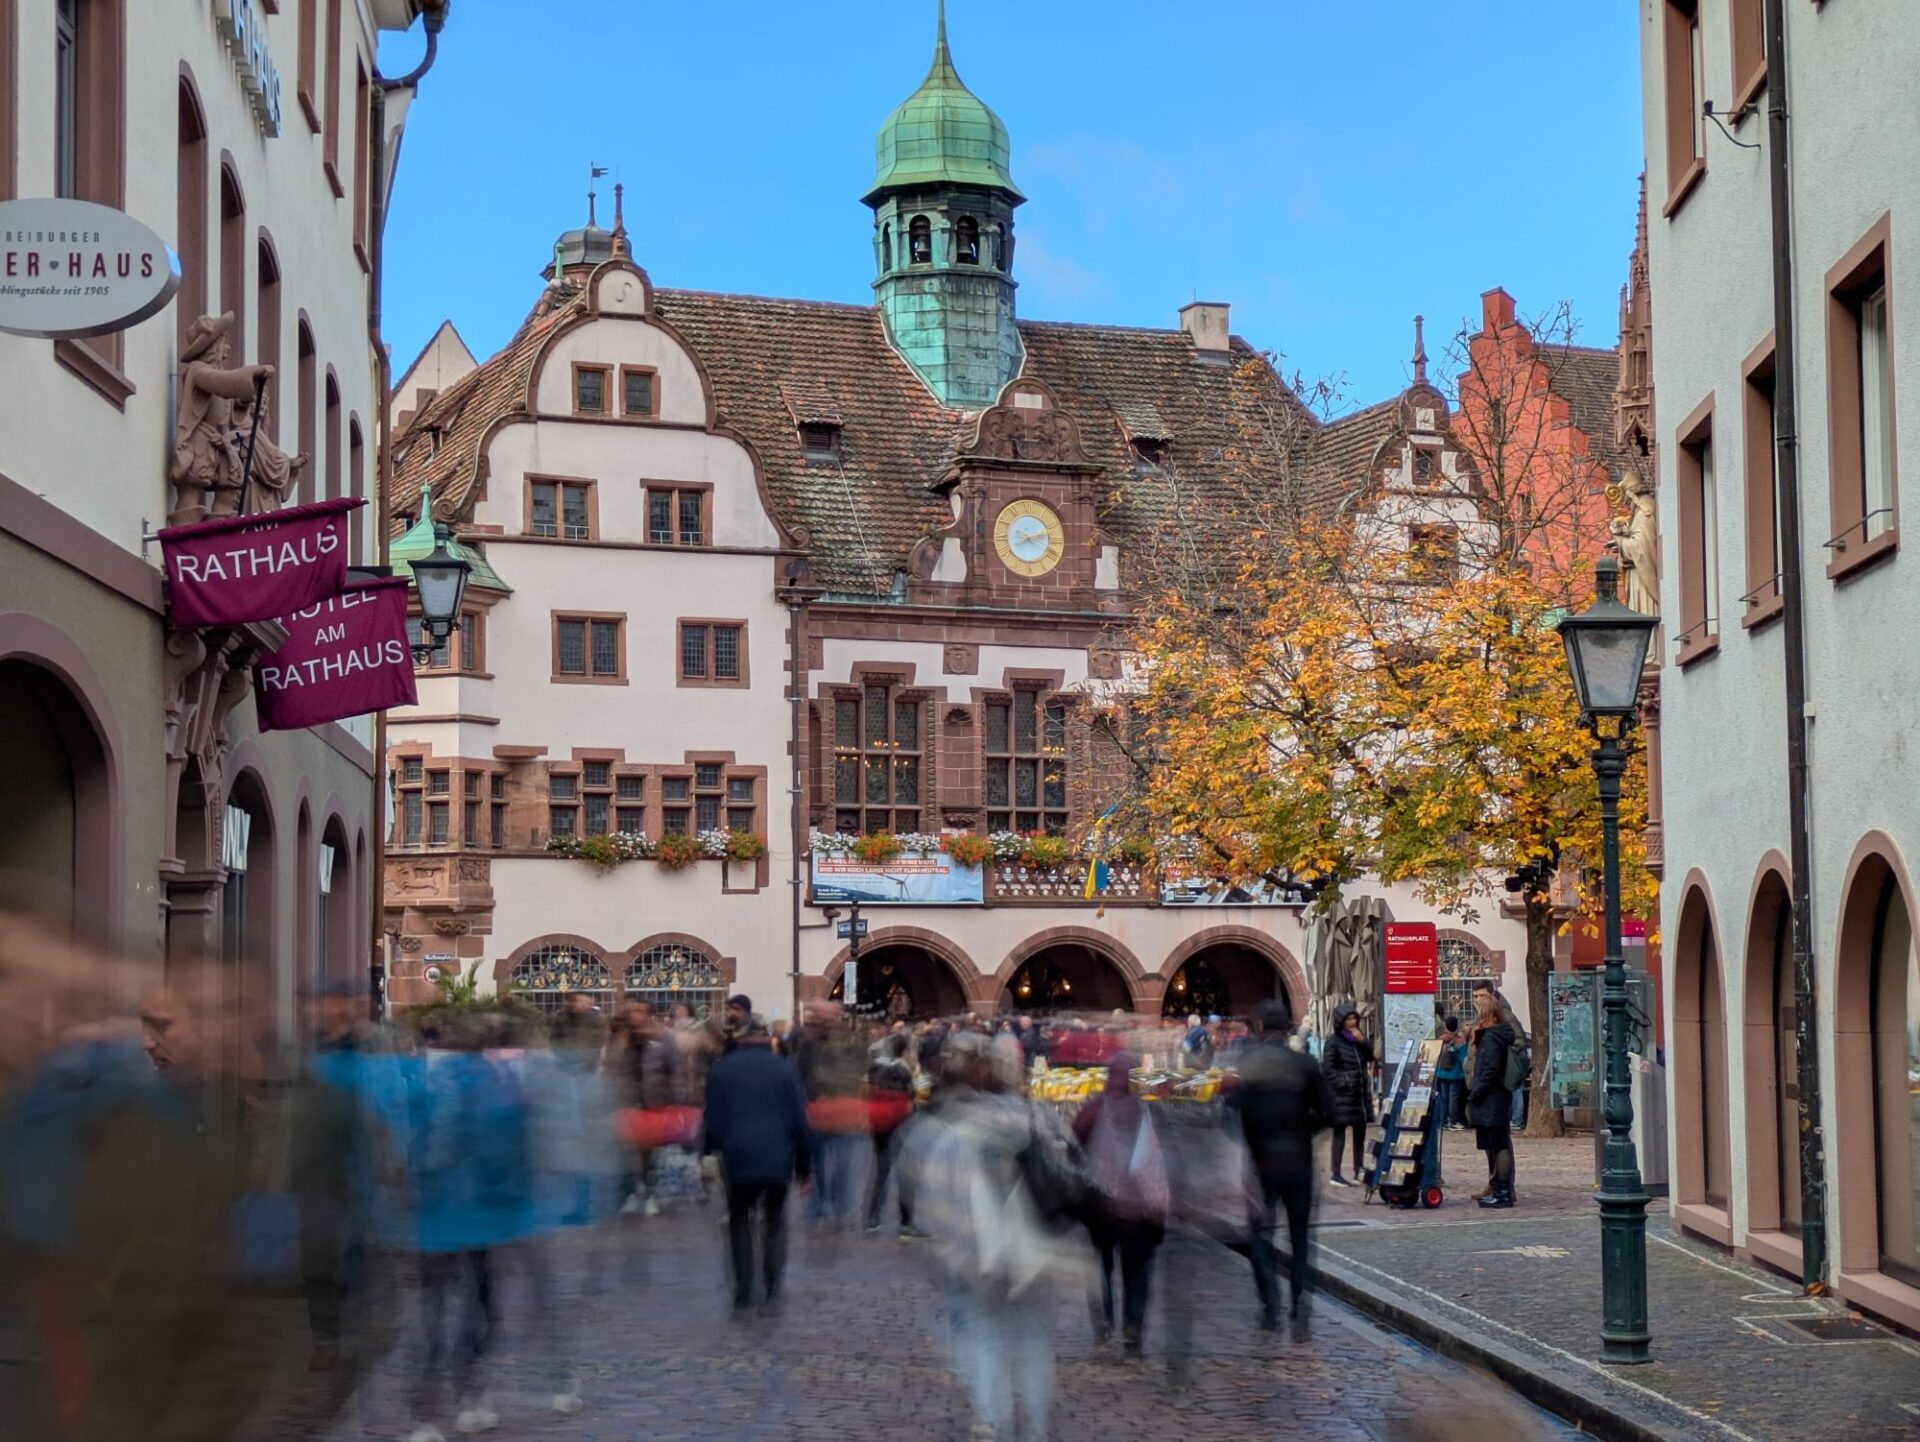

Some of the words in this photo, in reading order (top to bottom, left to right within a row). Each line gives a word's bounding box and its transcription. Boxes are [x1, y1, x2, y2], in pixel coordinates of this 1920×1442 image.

[225, 0, 282, 138] ATHAUS
[0, 231, 100, 243] REIBURGER
[68, 252, 153, 278] HAUS
[63, 286, 82, 296] seit
[84, 286, 110, 296] 1905
[176, 524, 339, 582] RATHAUS
[314, 623, 346, 646] AM
[261, 640, 404, 692] RATHAUS
